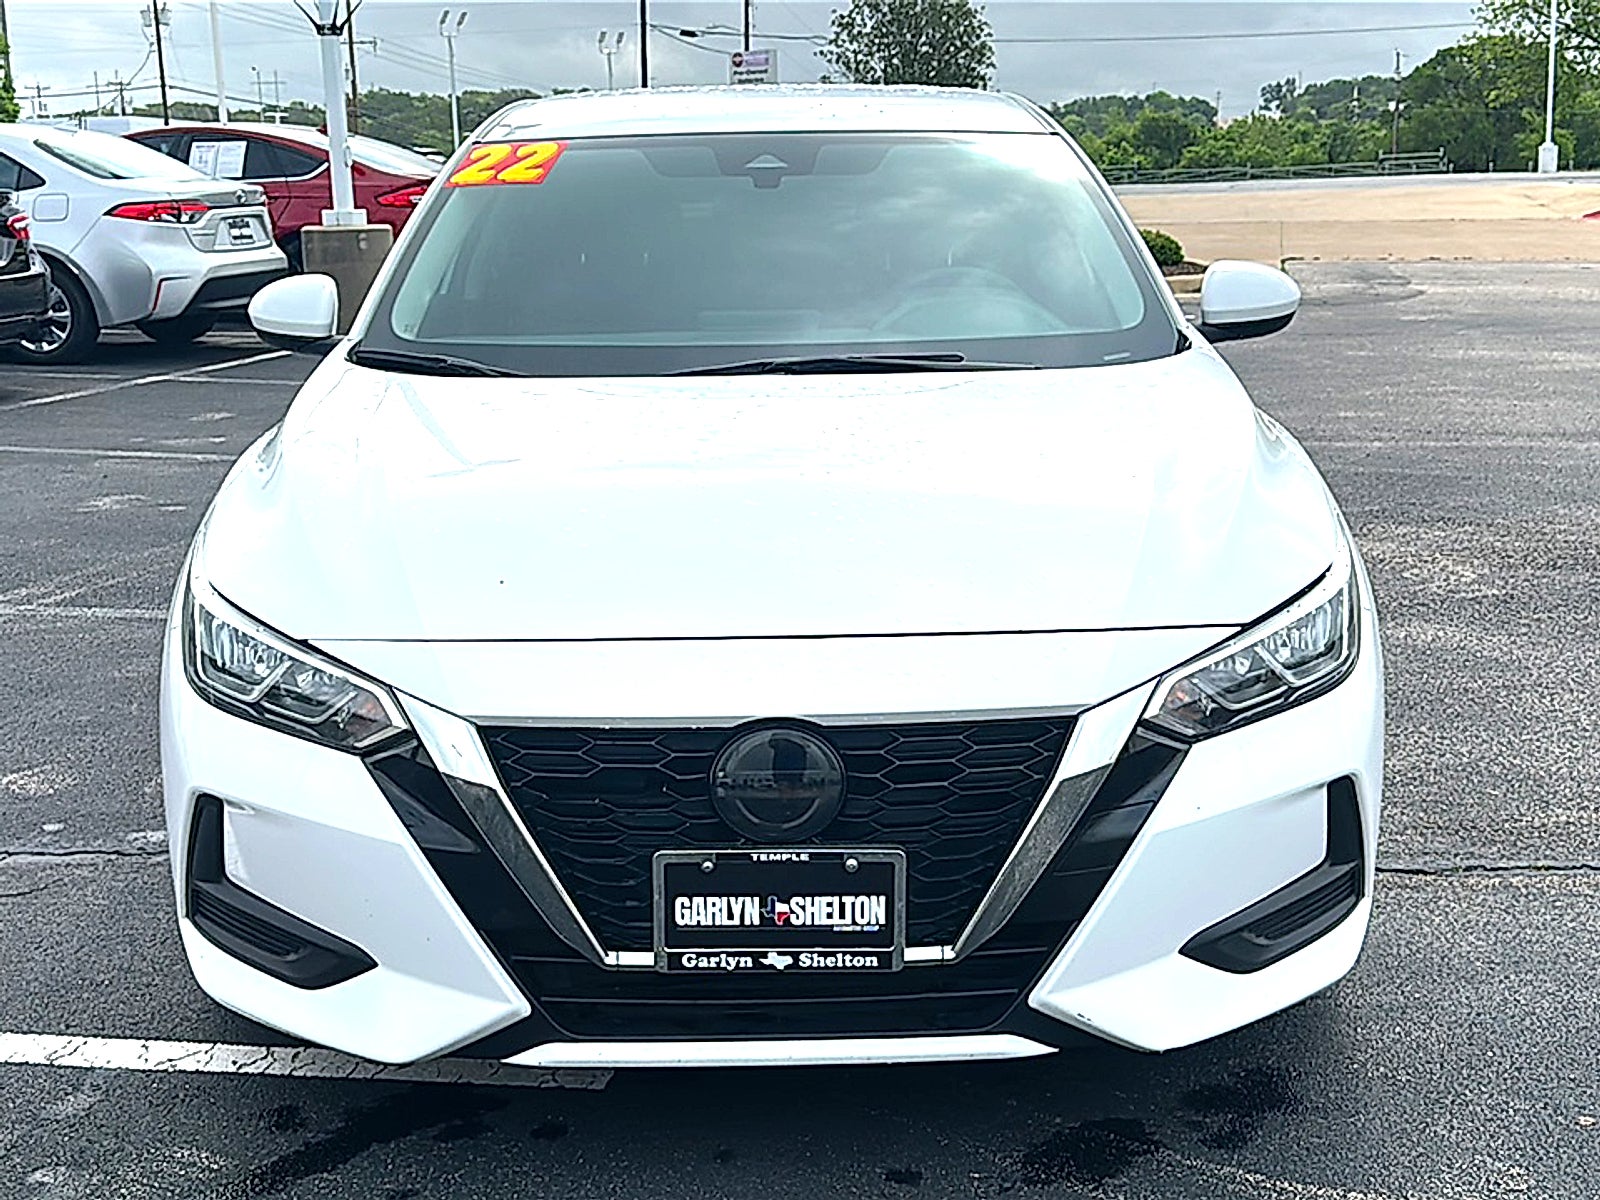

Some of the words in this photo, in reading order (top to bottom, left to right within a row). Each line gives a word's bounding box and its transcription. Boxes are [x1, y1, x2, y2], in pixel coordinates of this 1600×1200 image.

[449, 142, 560, 185] 22
[750, 853, 810, 862] TEMPLE
[674, 896, 760, 926] GARLYN
[790, 895, 886, 926] SHELTON
[681, 953, 753, 971] Garlyn
[798, 952, 878, 968] Shelton
